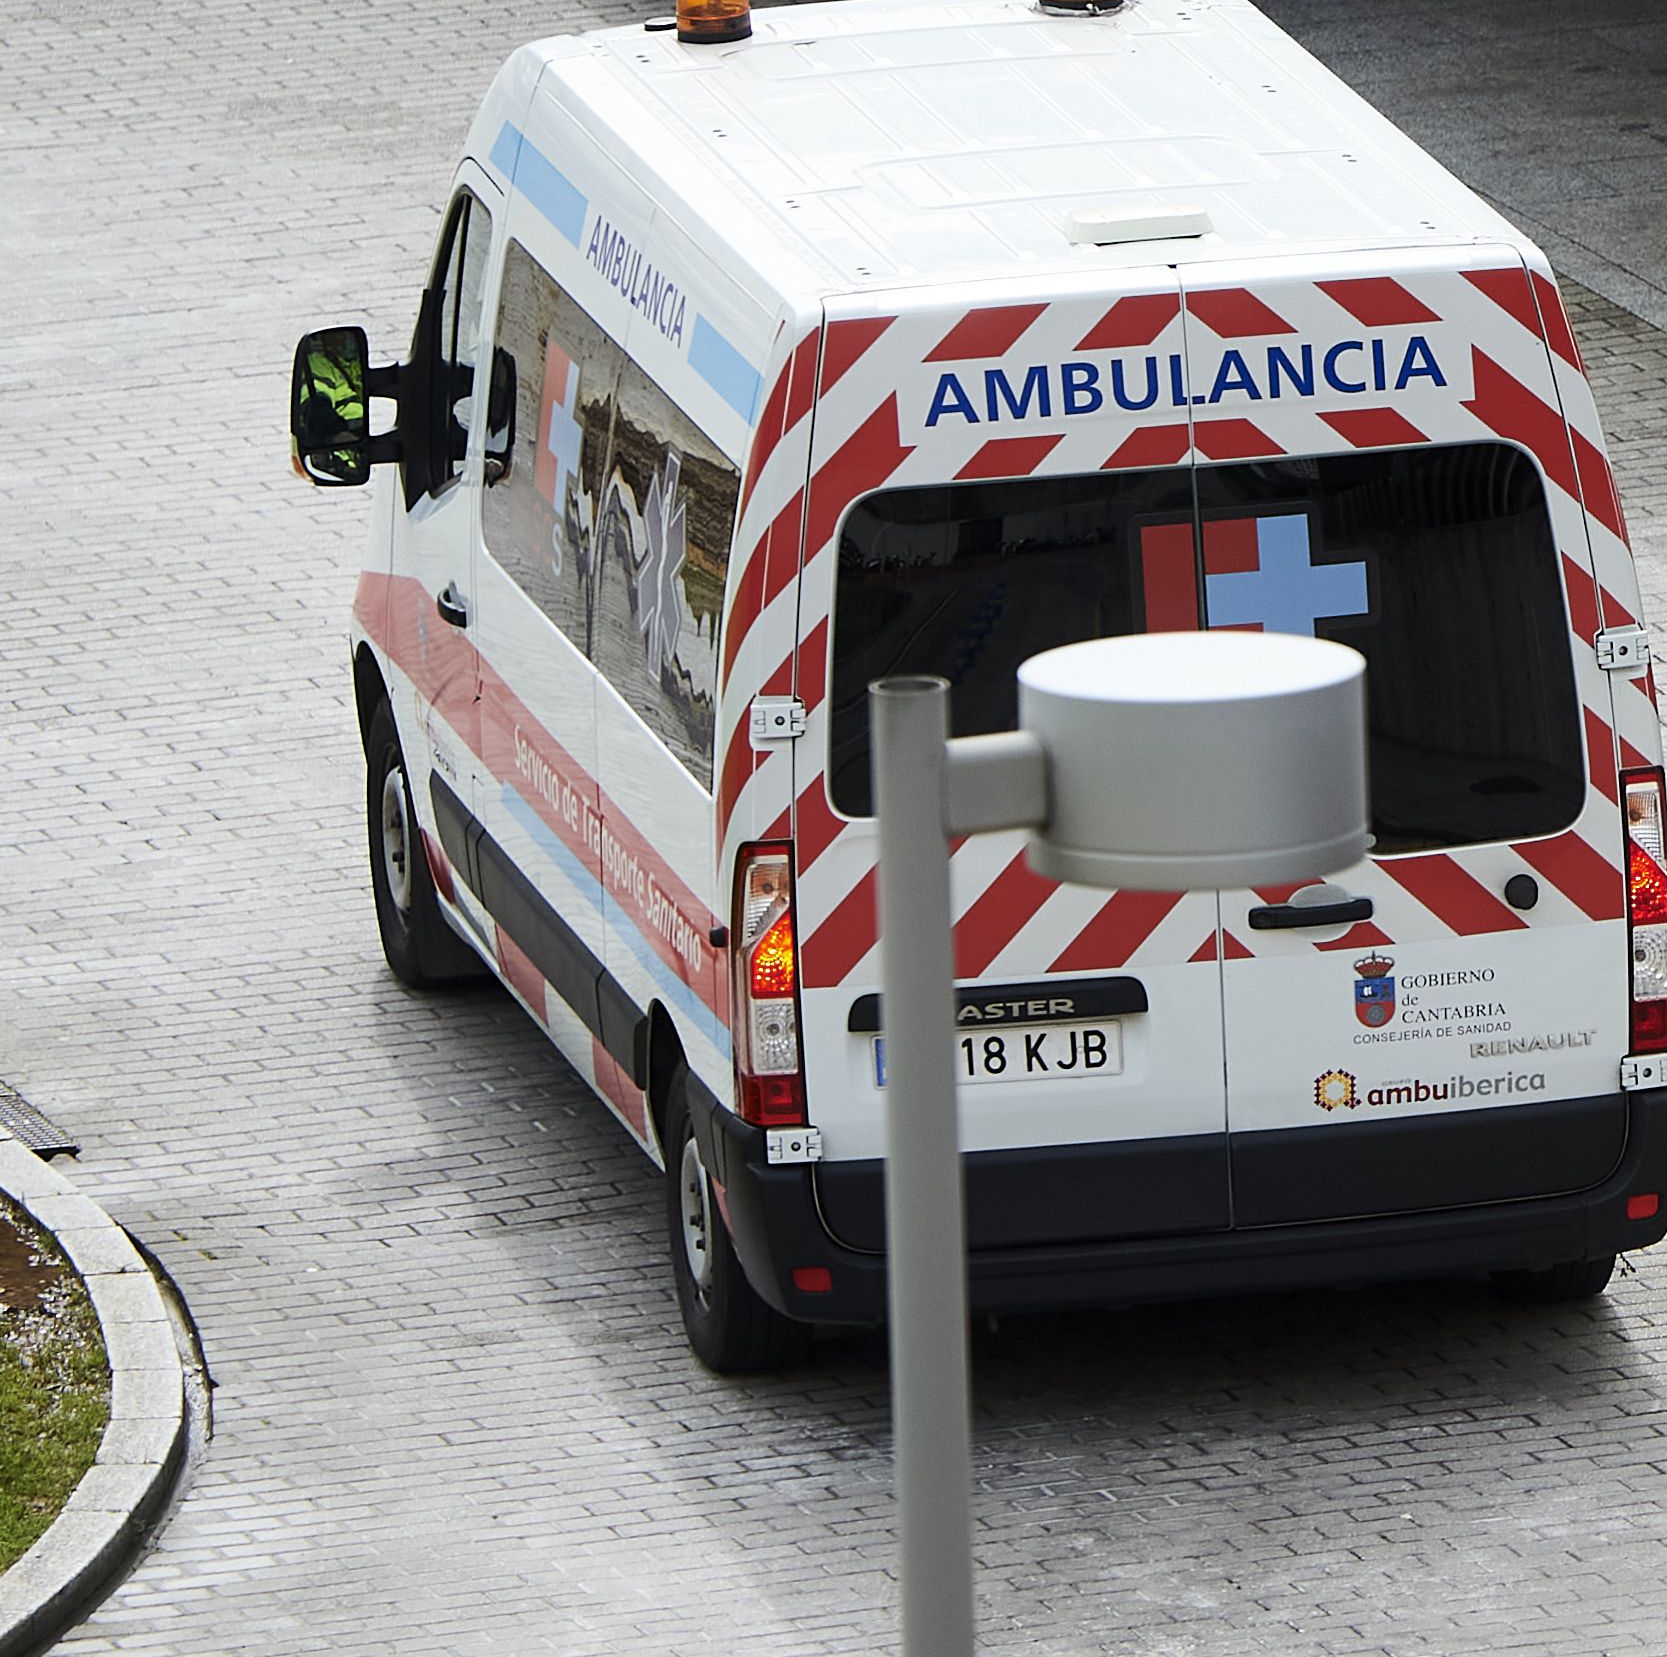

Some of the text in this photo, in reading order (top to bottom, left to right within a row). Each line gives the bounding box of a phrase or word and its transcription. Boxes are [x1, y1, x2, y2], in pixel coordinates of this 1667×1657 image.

[586, 215, 686, 348] AMBULANCIA
[923, 335, 1448, 428] AMBULANCIA
[514, 722, 702, 973] Servicio de Transporte Sanitario
[1401, 968, 1495, 989] GOBIERNO
[957, 998, 1075, 1021] ASTER
[1401, 993, 1419, 1007] de
[1402, 1002, 1506, 1024] CANTABRIA
[1353, 1021, 1512, 1045] CONSEJERÍA DE SANIDAD
[1470, 1029, 1597, 1059] RENAULT
[1025, 1029, 1107, 1072] KJB
[1367, 1071, 1546, 1107] ambuiberica
